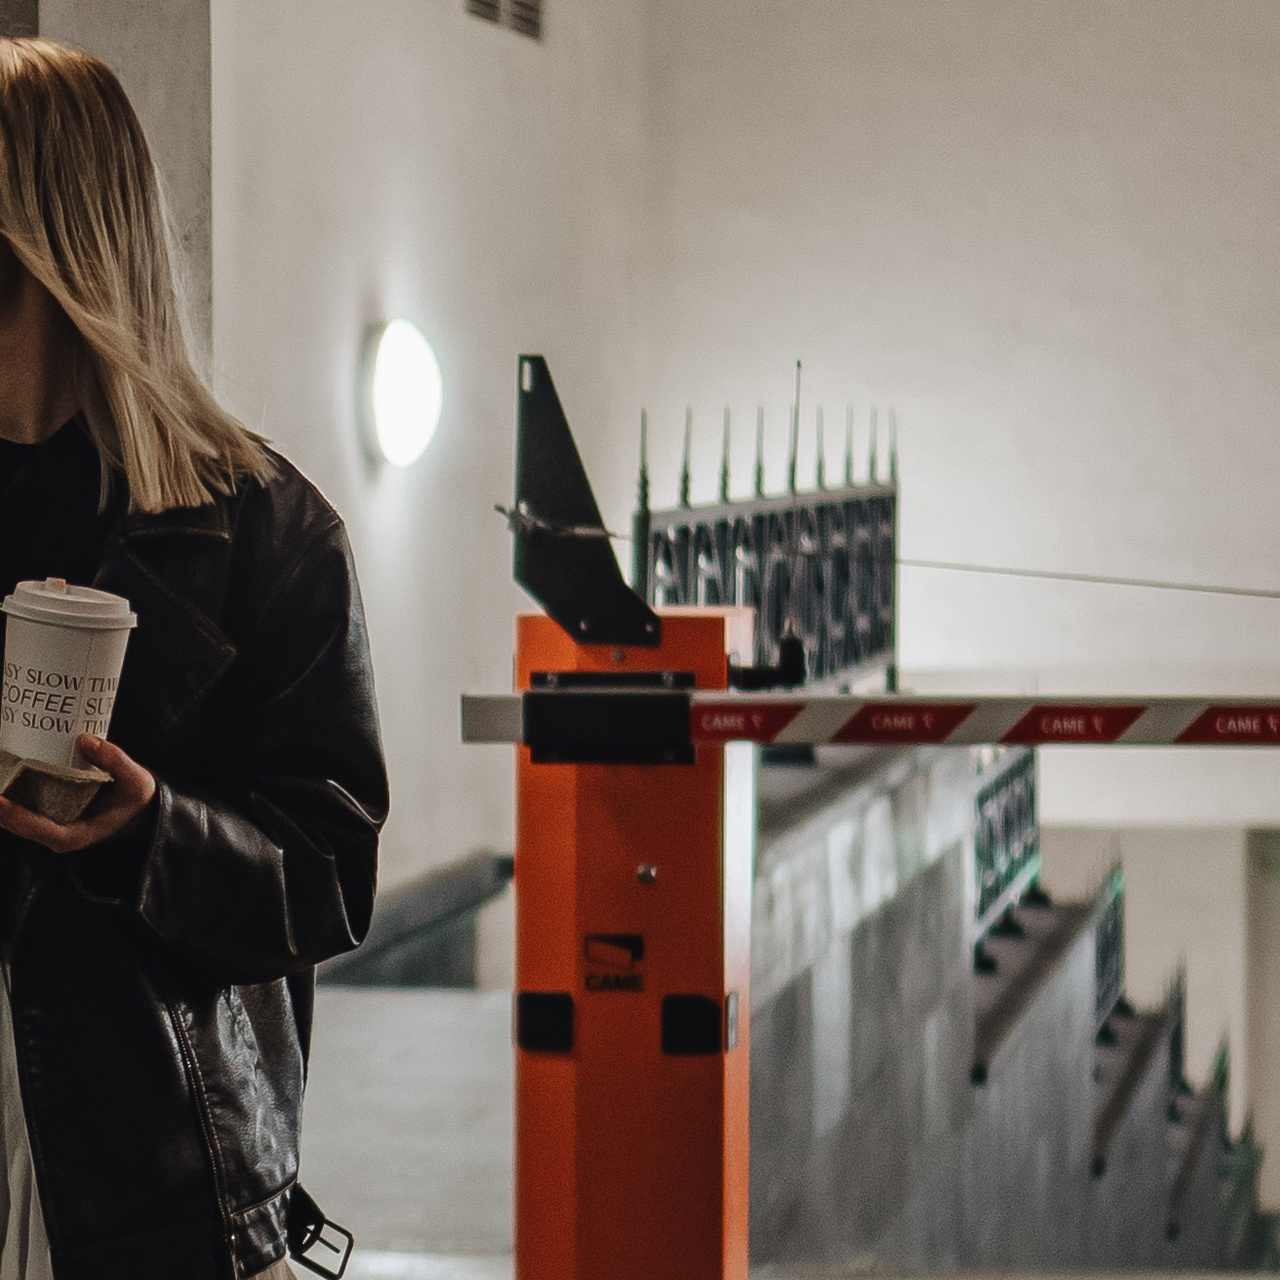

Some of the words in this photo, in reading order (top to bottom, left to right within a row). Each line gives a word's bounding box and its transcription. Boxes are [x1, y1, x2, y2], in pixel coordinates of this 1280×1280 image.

[3, 661, 22, 680] SY
[26, 668, 83, 691] SLOW
[2, 705, 19, 724] SY
[21, 711, 76, 735] SLOW
[701, 714, 745, 731] CAME
[872, 714, 916, 733] CAME
[1040, 715, 1085, 734] CAME
[1215, 716, 1261, 735] CAME
[584, 972, 644, 992] CAME
